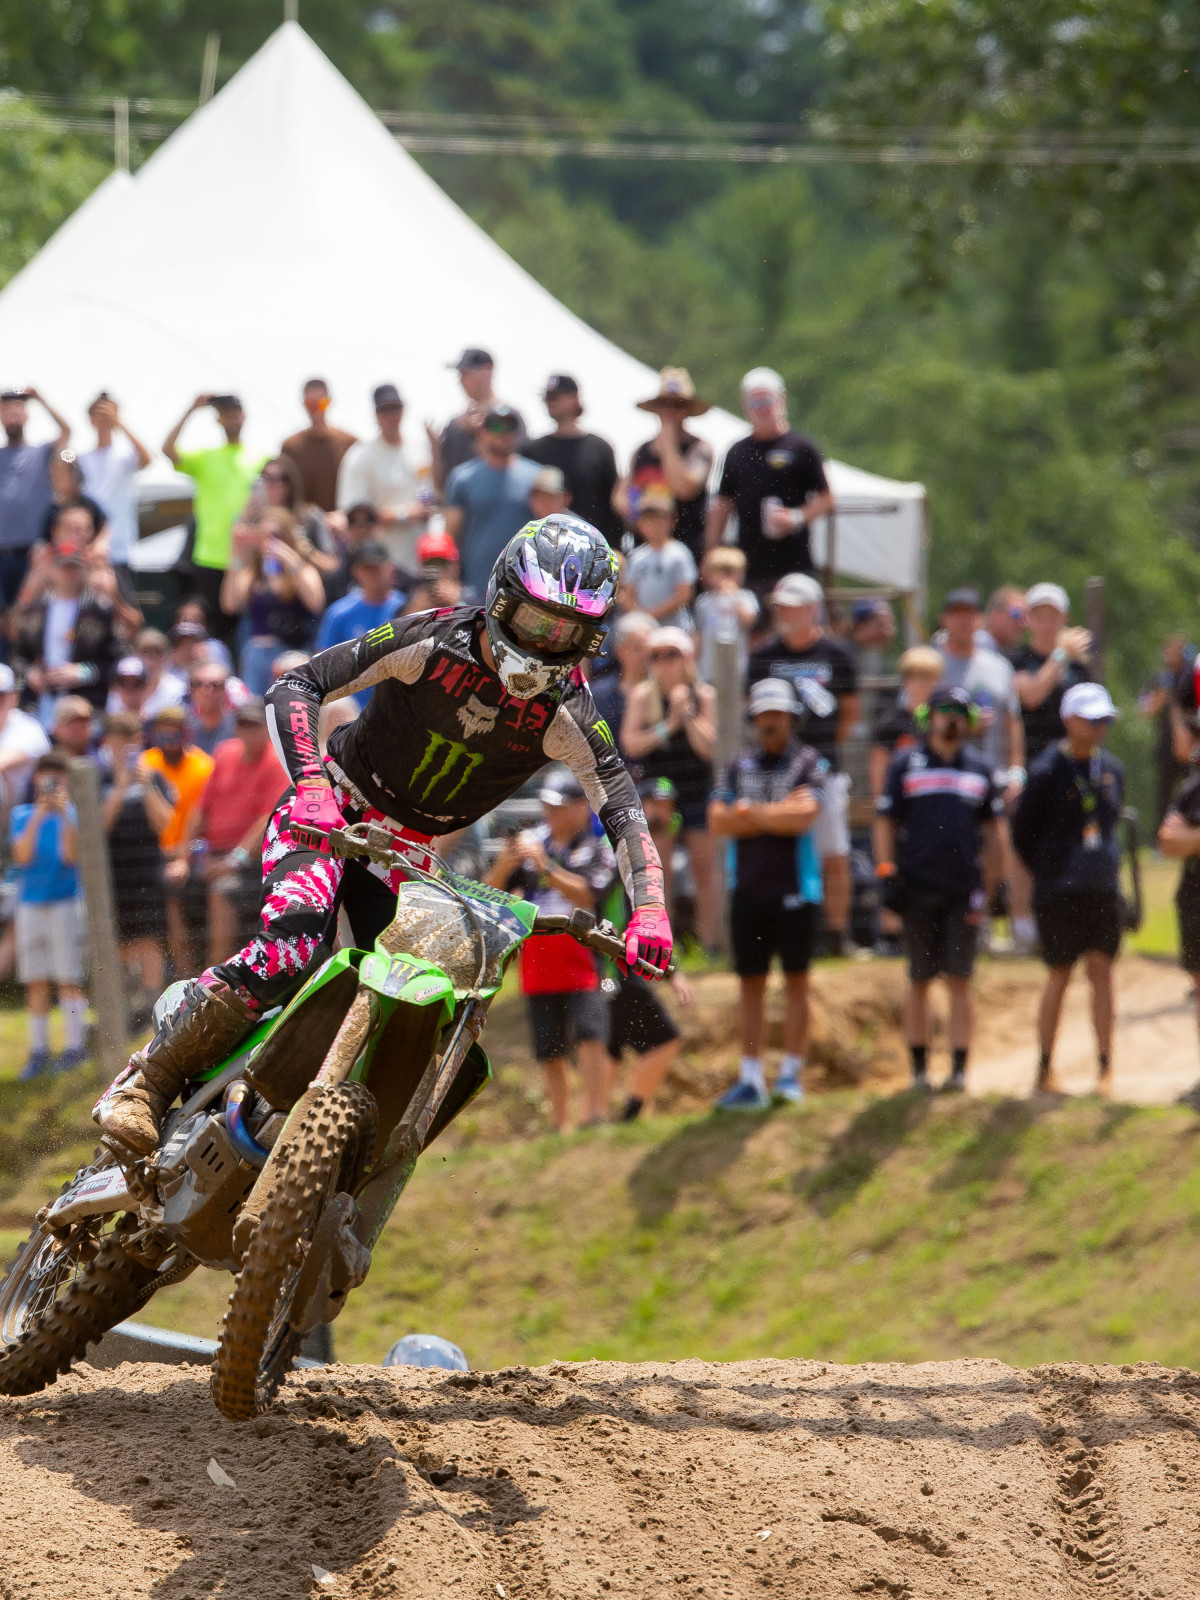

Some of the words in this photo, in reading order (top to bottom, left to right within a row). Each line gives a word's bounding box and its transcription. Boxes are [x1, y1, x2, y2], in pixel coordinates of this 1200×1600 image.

[491, 597, 508, 618] FOX
[588, 632, 603, 653] FOX
[306, 792, 321, 829] FOX
[642, 913, 658, 941] FOX
